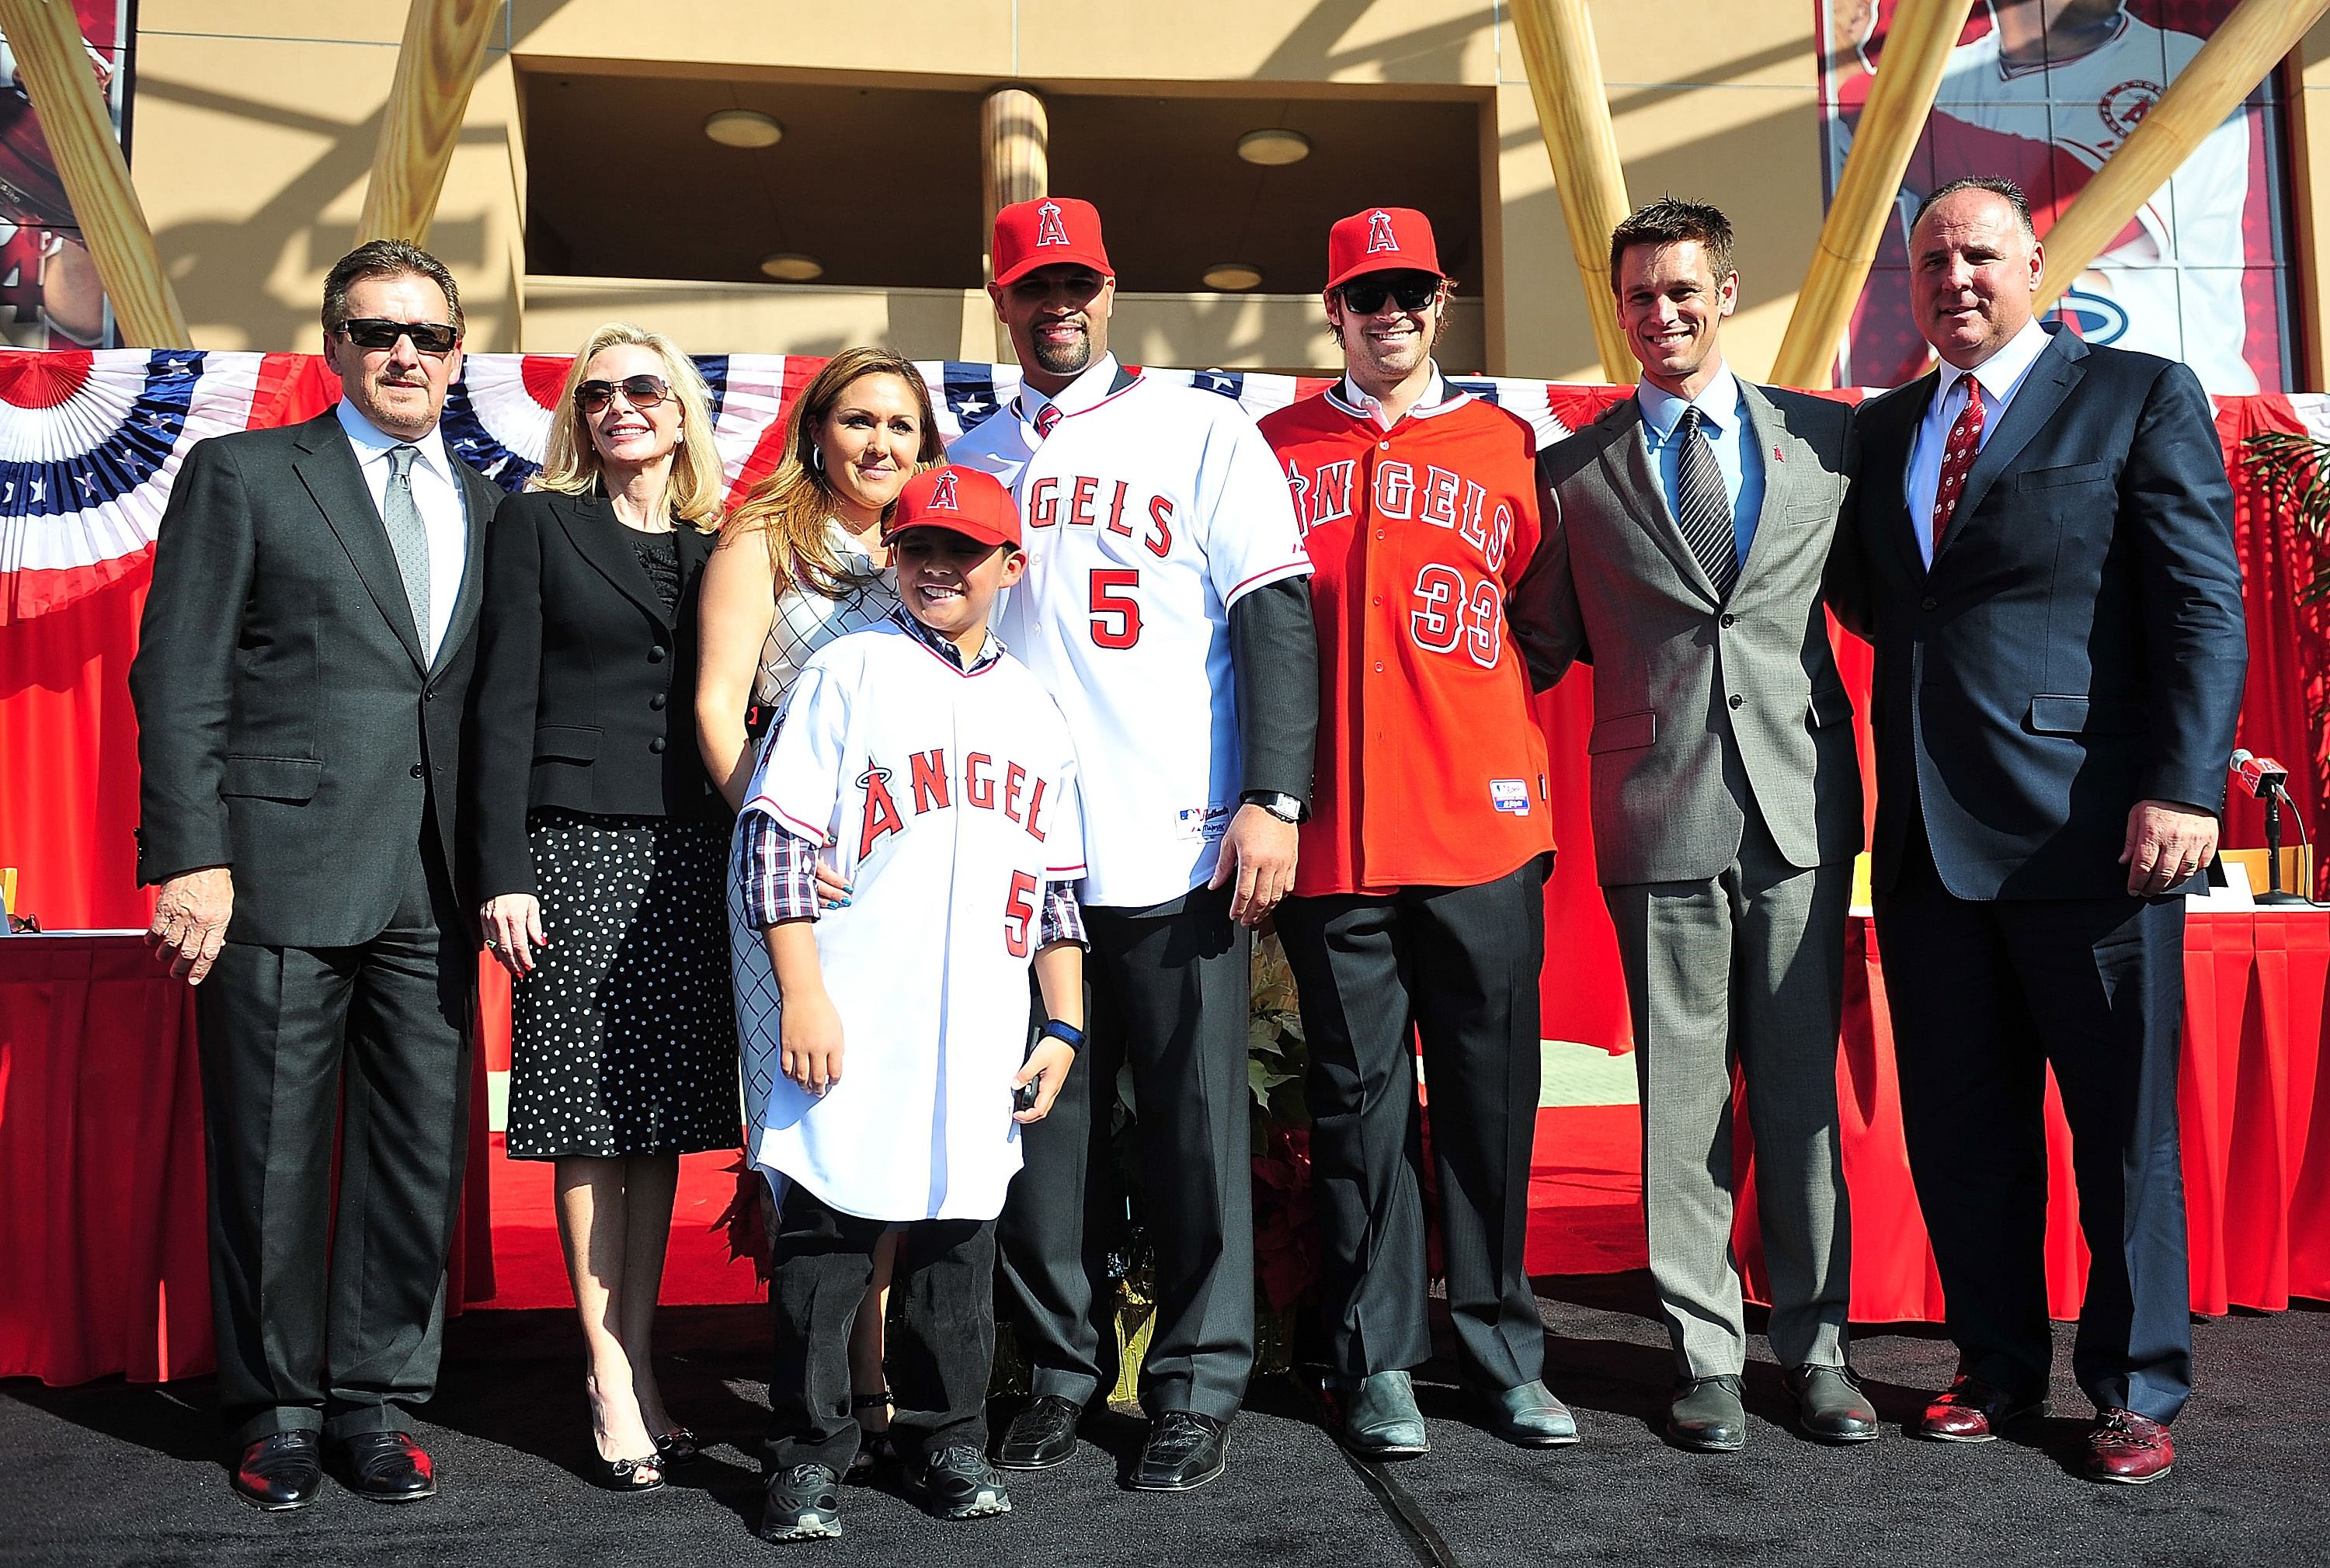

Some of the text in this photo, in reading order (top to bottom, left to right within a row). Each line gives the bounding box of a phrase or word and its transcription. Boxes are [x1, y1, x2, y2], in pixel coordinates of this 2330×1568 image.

[1036, 201, 1070, 247] A
[1366, 210, 1400, 254] A
[927, 470, 959, 510] A
[1007, 475, 1174, 558] GELS
[1090, 568, 1144, 650] 5
[1411, 563, 1501, 669] 33
[1005, 869, 1038, 958] 5
